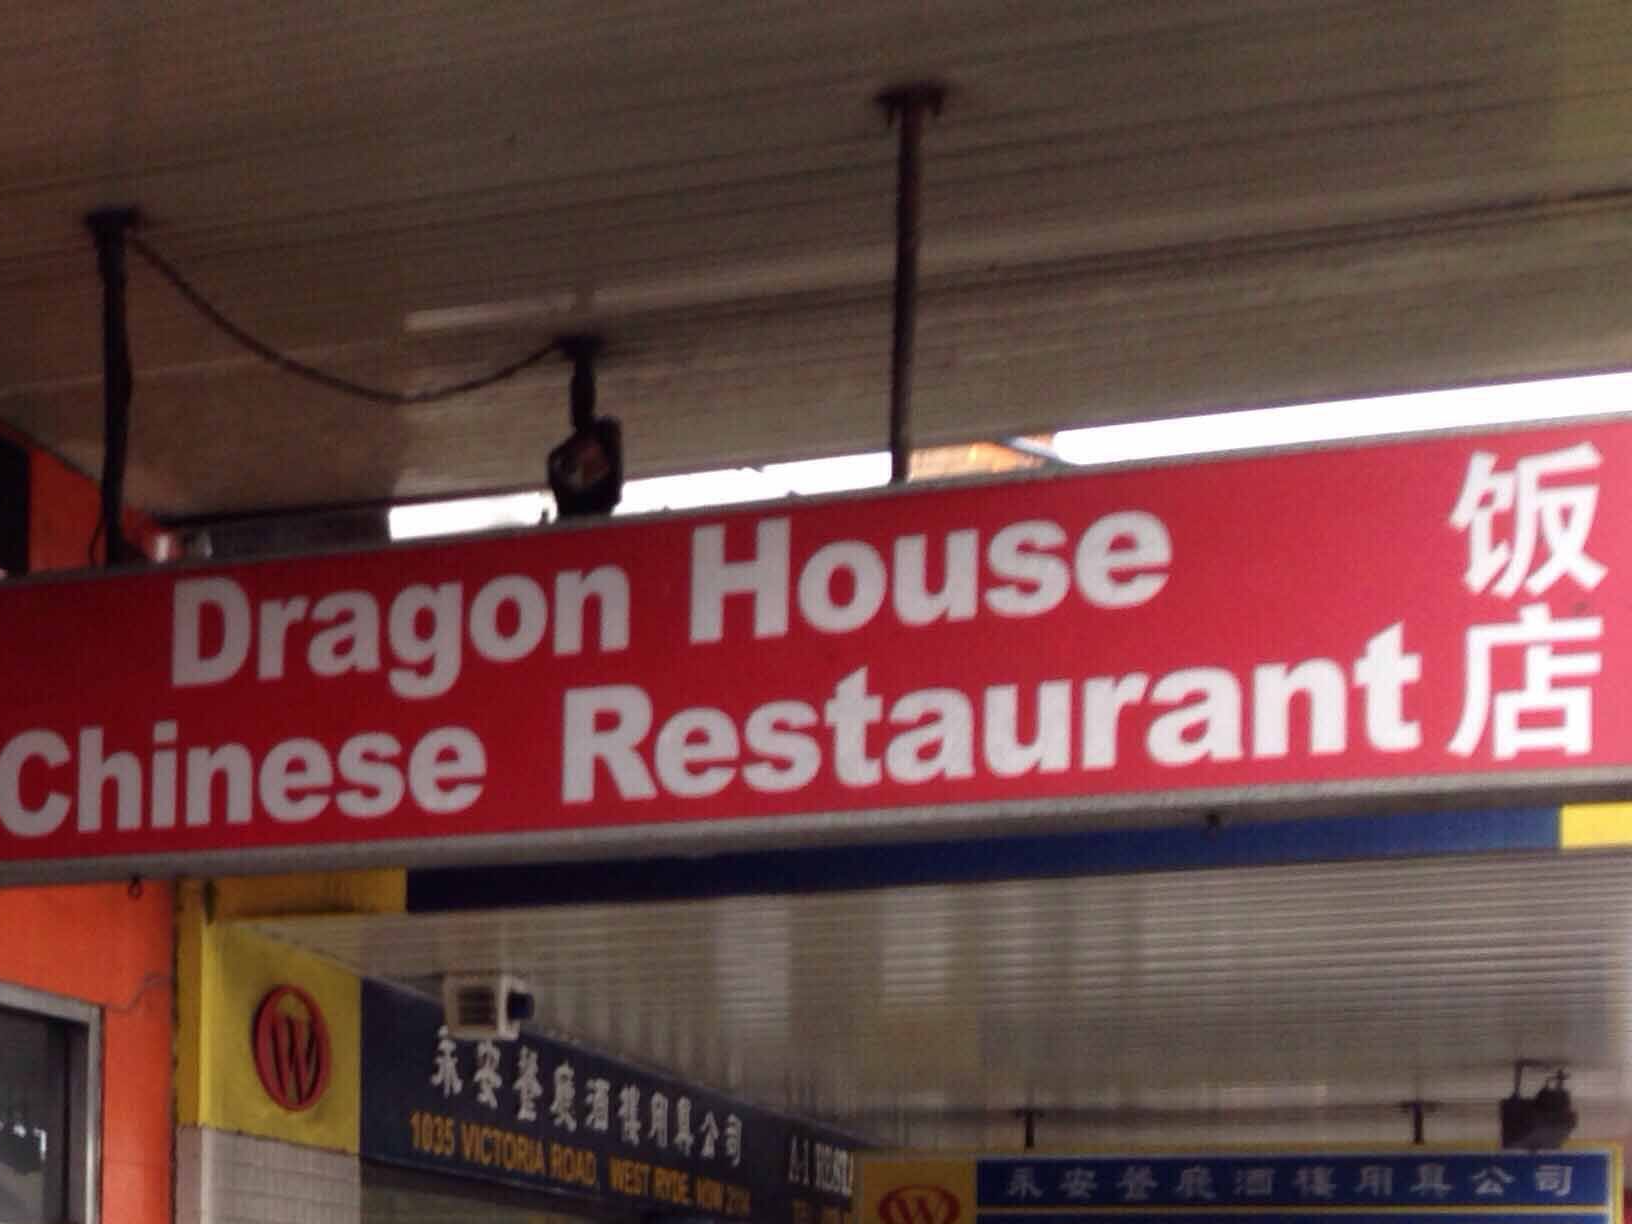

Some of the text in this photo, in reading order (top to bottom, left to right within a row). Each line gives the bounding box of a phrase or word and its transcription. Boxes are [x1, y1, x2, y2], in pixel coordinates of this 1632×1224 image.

[171, 508, 1173, 700] Dragon House
[1448, 440, 1609, 760] 饭店
[563, 622, 1422, 804] Restaurant
[461, 1121, 545, 1175] VICTORIA
[549, 1141, 598, 1185] ROAD
[608, 1155, 650, 1197] WEST
